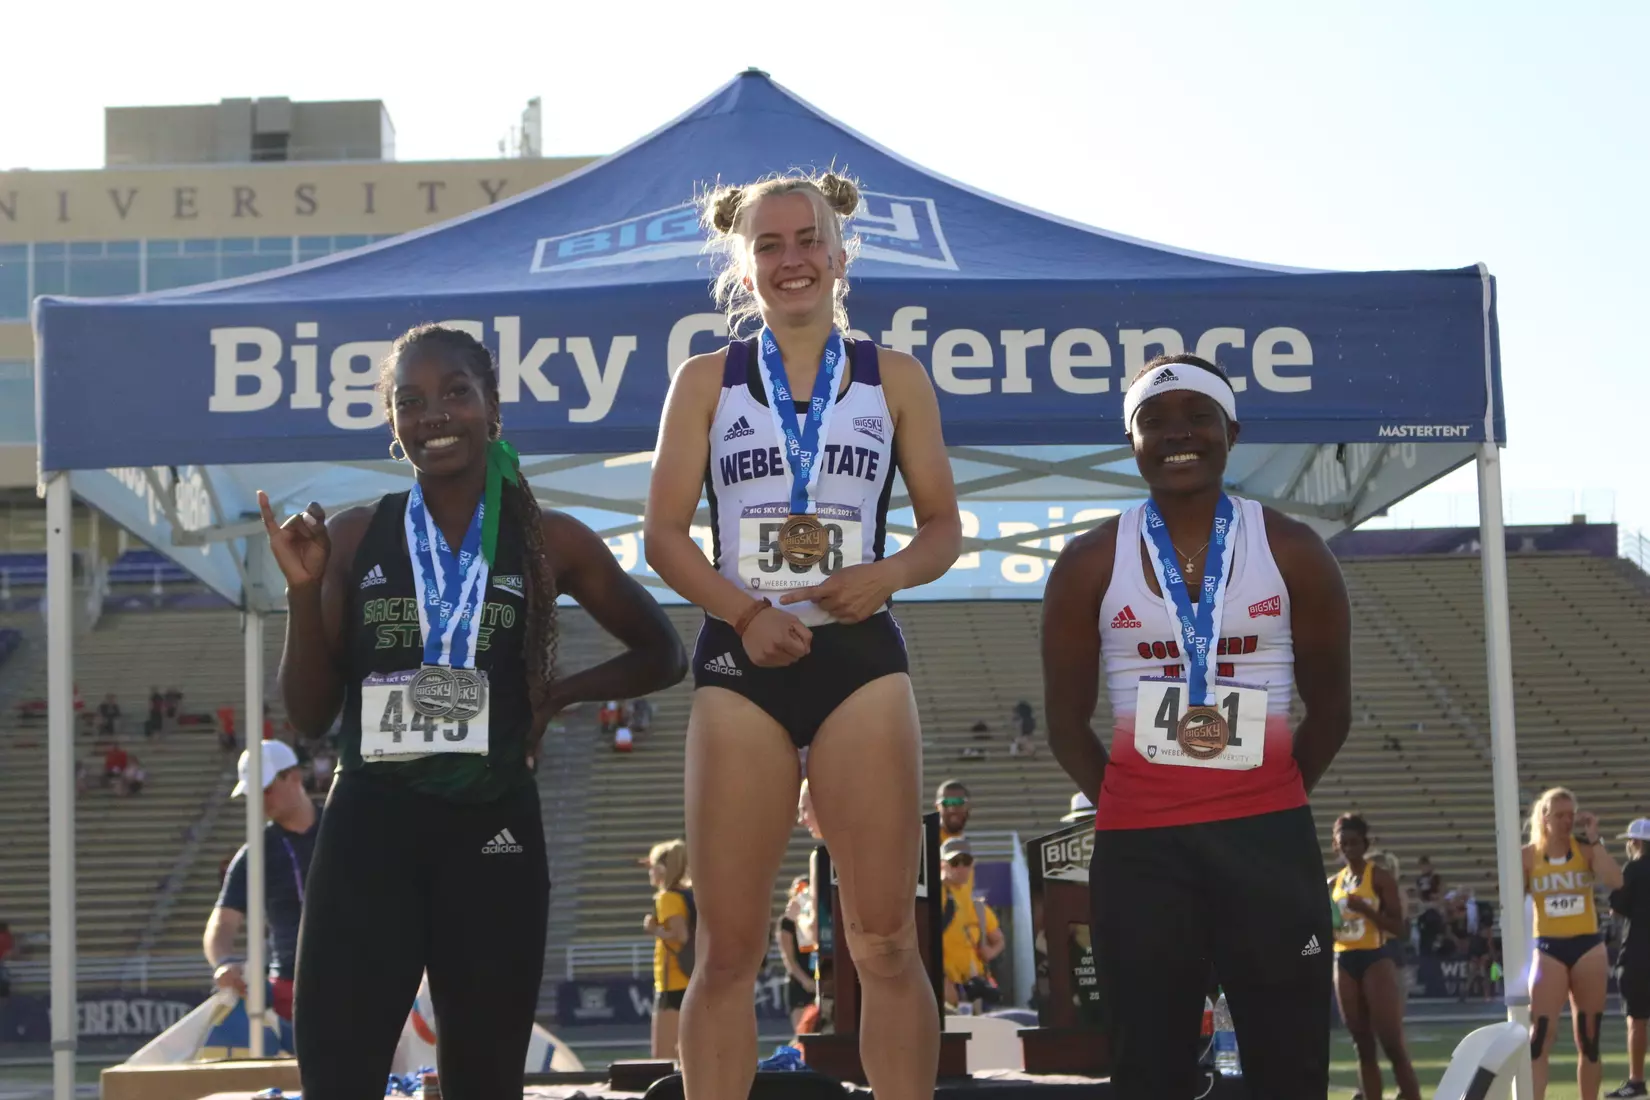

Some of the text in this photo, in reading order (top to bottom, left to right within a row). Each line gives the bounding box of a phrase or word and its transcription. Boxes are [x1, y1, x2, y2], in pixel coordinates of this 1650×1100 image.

[208, 306, 1314, 430] Big ky Cference
[1154, 376, 1179, 386] adidas
[854, 418, 883, 433] BIGSKY
[1378, 424, 1470, 437] MASTERTENT
[723, 428, 755, 442] adidas
[720, 444, 880, 487] WEBE TATE
[786, 530, 821, 546] BIGSKY
[758, 523, 844, 576] 58
[360, 577, 387, 589] adidas
[1249, 597, 1280, 613] BIGSKY
[363, 598, 516, 629] SACRTO
[1110, 619, 1142, 629] adidas
[375, 623, 496, 651] STE
[704, 662, 743, 677] adidas
[415, 682, 452, 697] BIGSKY
[1154, 686, 1243, 747] 41
[1184, 723, 1221, 738] BIGSKY
[481, 844, 524, 854] adidas
[1046, 833, 1096, 863] BIGS
